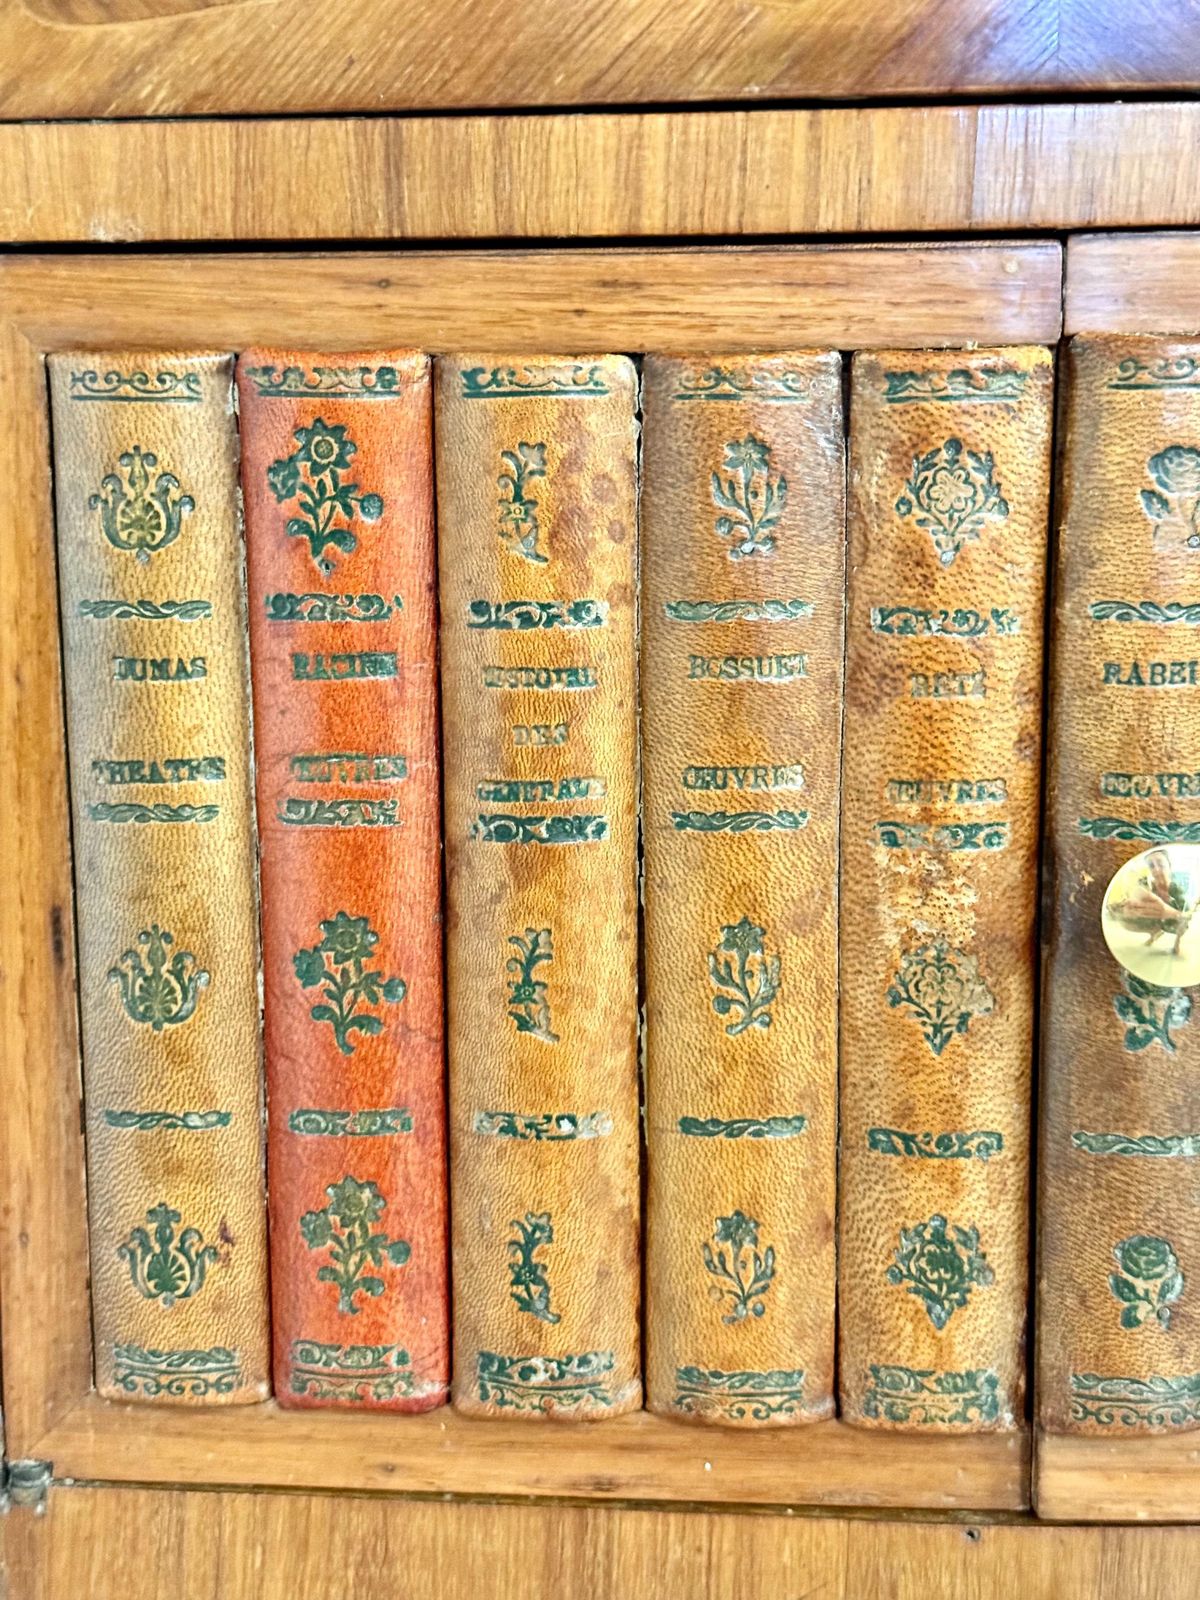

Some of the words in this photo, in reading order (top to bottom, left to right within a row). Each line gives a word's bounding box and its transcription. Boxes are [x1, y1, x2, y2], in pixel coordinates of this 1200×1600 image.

[112, 655, 207, 681] DUMAS
[687, 653, 808, 681] BOSSUET
[512, 723, 569, 746] DES
